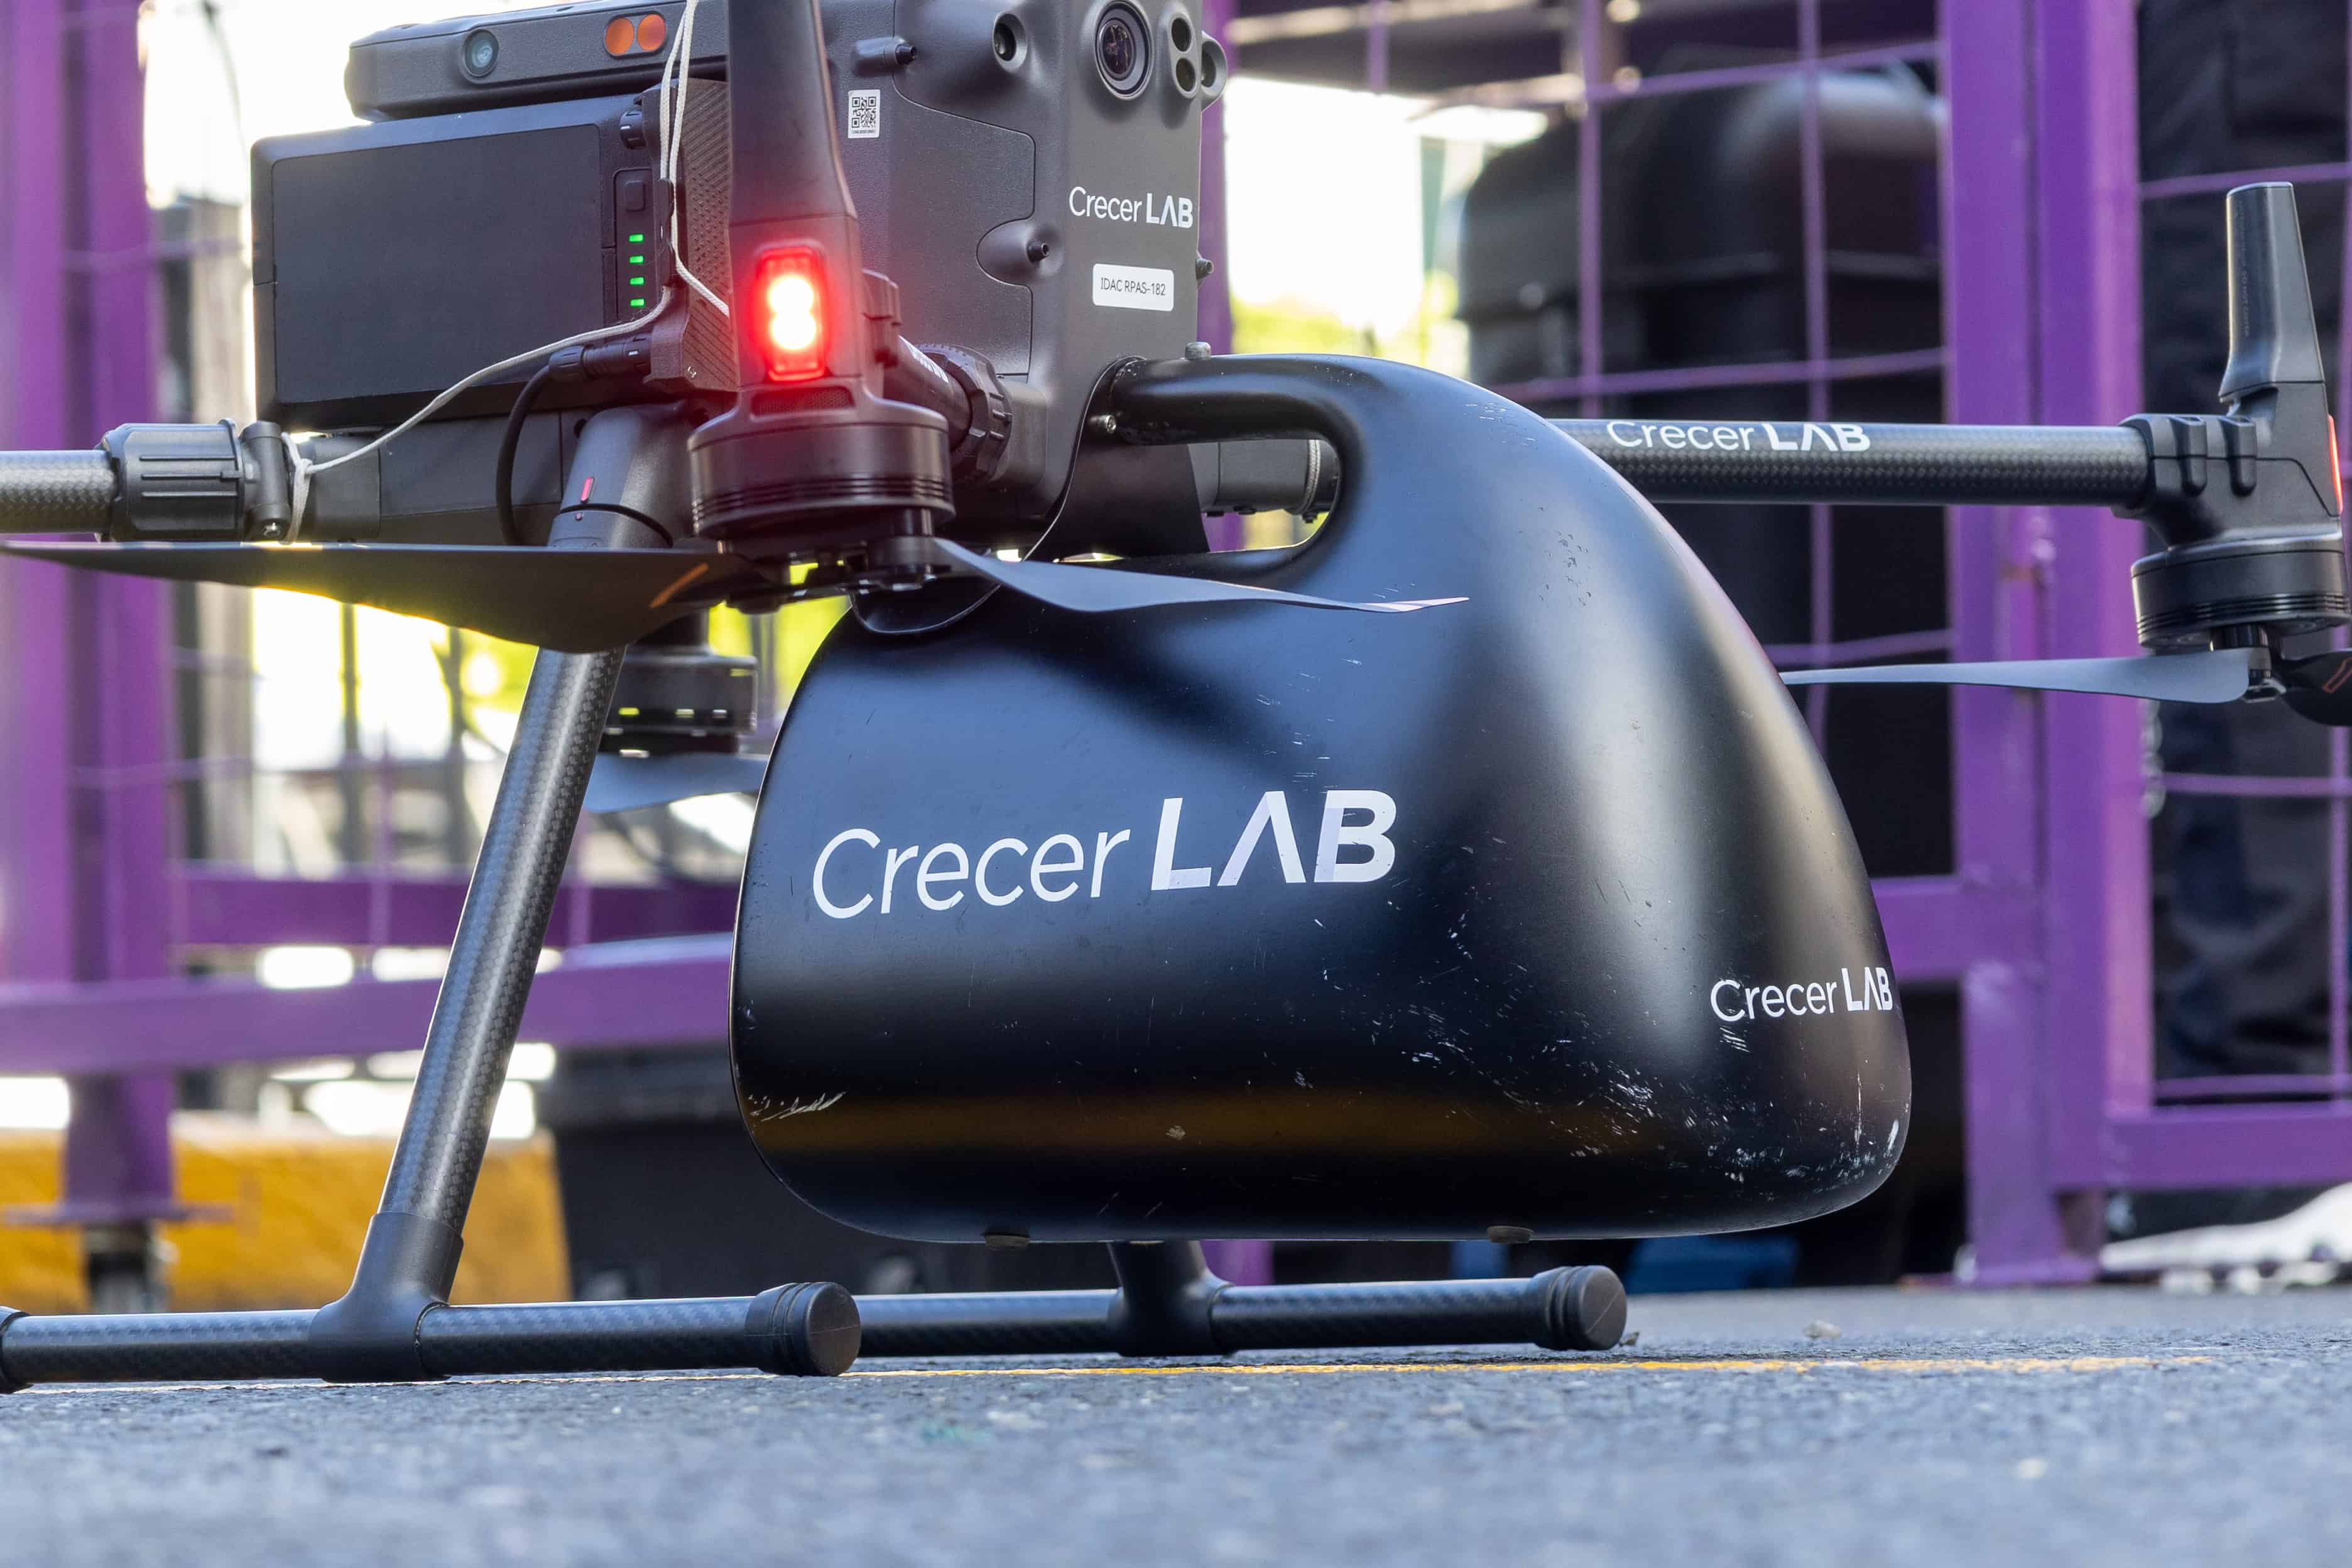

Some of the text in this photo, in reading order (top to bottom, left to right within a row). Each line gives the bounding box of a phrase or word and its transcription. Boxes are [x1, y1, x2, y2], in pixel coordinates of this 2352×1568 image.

[1069, 186, 1194, 229] Crecer LAB
[1101, 277, 1166, 296] IDAC RPAS-182
[1606, 420, 1871, 452] Crecer LAB
[812, 790, 1396, 919] Crecer LAB
[1711, 967, 1893, 1021] Crecer LAB
